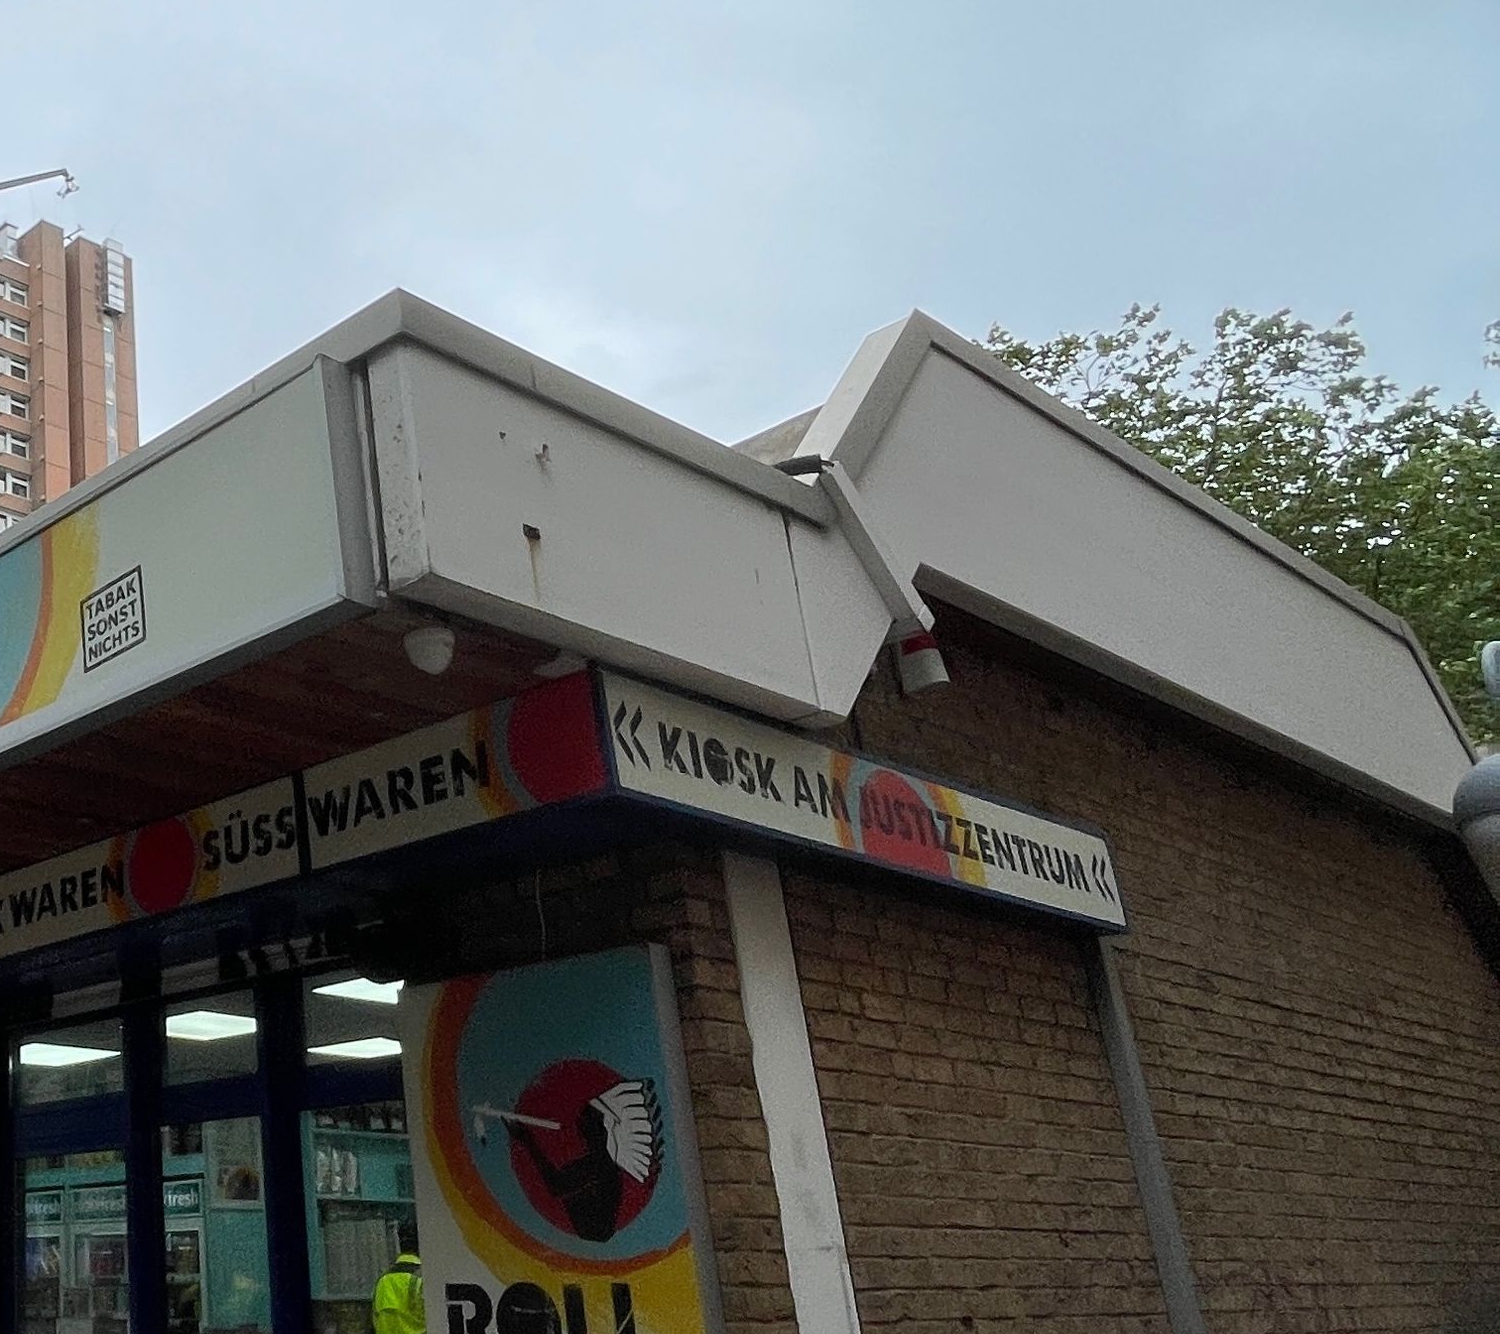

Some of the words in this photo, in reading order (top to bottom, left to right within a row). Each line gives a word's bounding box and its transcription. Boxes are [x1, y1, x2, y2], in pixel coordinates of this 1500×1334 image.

[85, 577, 136, 620] TABAK
[87, 598, 137, 641] SONST
[88, 620, 140, 662] NICHTS
[307, 738, 489, 837] WAREN
[656, 720, 782, 803] KIOSK
[793, 766, 850, 823] AM
[857, 784, 1090, 893] JUSTIZZENTRUM
